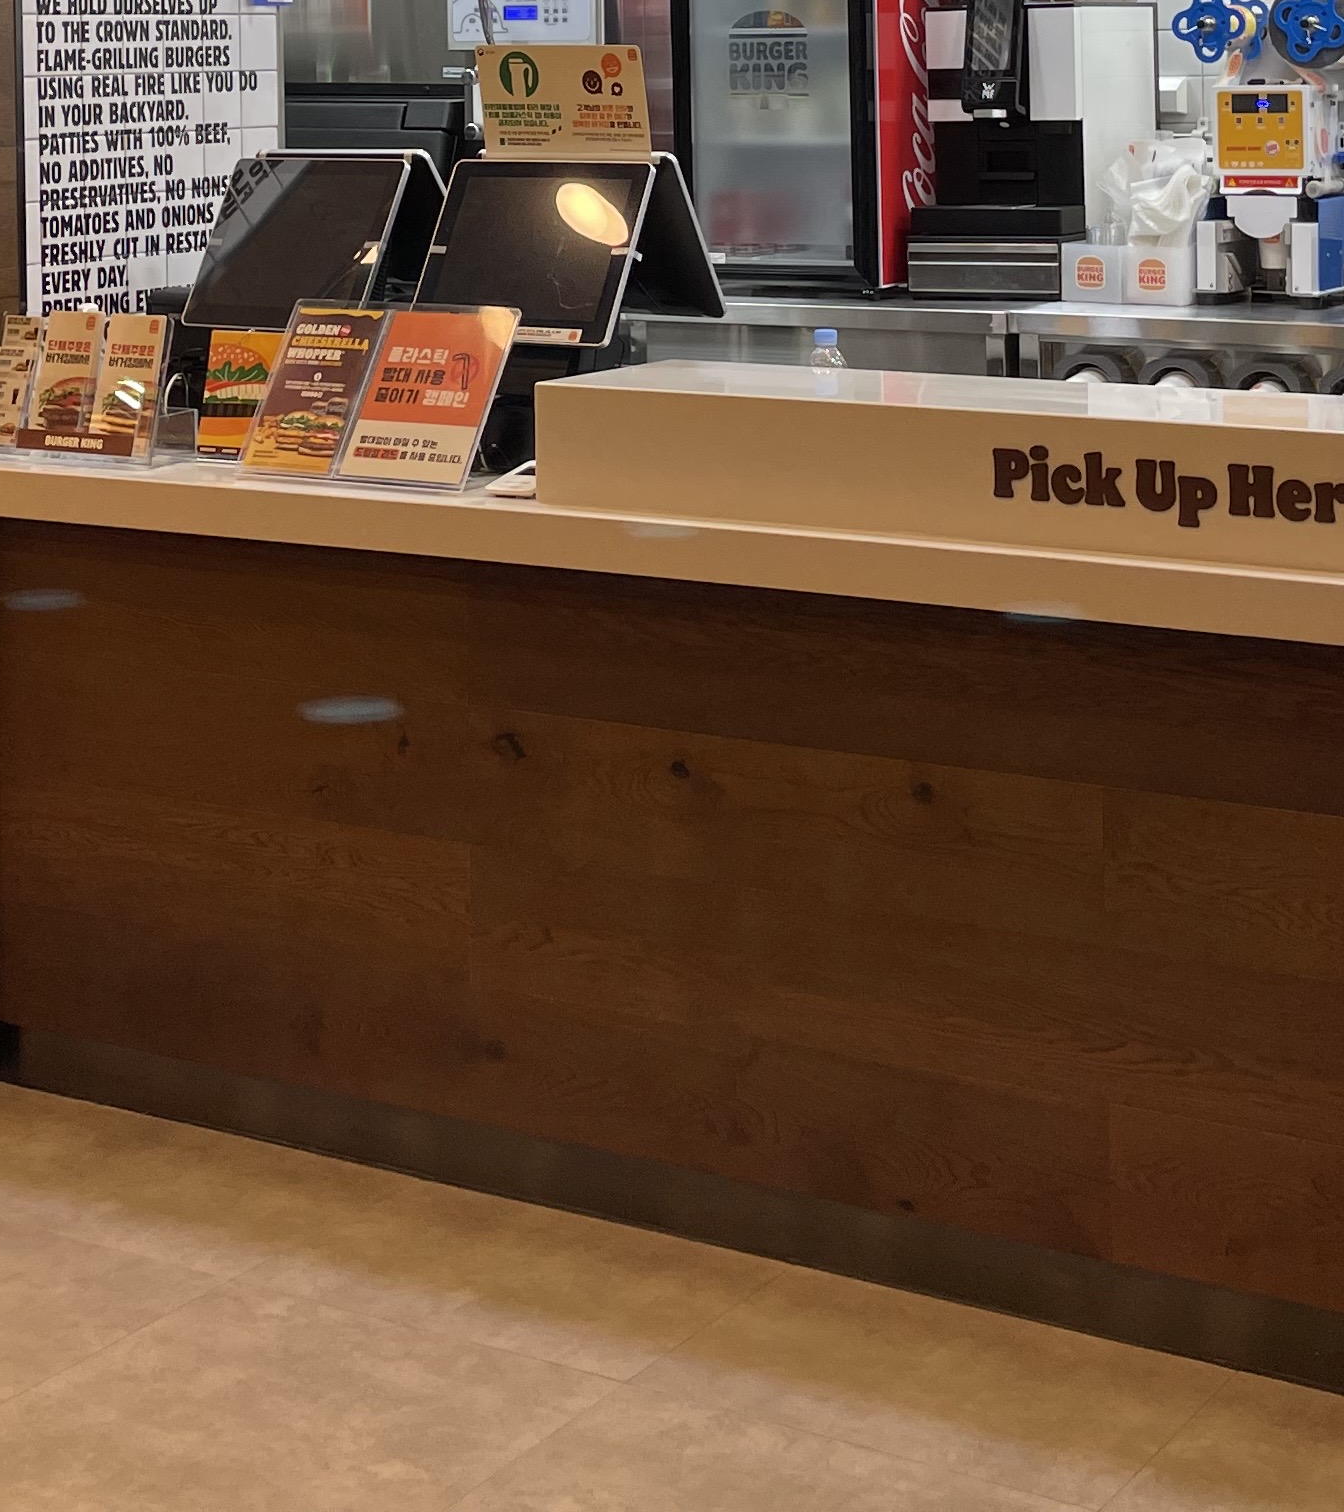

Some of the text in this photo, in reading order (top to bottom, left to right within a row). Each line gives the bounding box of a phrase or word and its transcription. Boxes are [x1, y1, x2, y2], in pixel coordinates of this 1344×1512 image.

[37, 19, 232, 43] TO THE CROWN STANDARD.
[37, 46, 230, 71] FLAME-GRILLING BURGERS
[729, 42, 807, 61] BURGER
[38, 71, 257, 99] USING REAL FIRE LIKE YOU DO
[730, 62, 808, 90] KING
[38, 100, 189, 128] IN YOUR BACKYARD.
[39, 123, 230, 156] PATTIES WITH 100% BEEF,
[39, 154, 173, 184] NO ADDITIVES, NO
[40, 181, 160, 212] PRESERVATIVES,
[165, 178, 186, 201] NO
[40, 202, 214, 238] TOMATOES AND ONIONS
[41, 239, 105, 267] FRESHLY
[113, 238, 139, 259] CUT
[145, 235, 159, 256] IN
[42, 265, 128, 294] EVERY DAY.
[1078, 273, 1103, 281] KING
[1139, 276, 1165, 284] KING
[296, 323, 341, 336] GOLDEN
[286, 347, 342, 360] WHOPPER
[388, 347, 449, 365] 플라스틱
[381, 367, 446, 386] 빨대 사용
[374, 387, 469, 408] 줄이기 캠페인
[45, 435, 103, 449] BURGER KING
[993, 445, 1126, 508] Pick
[1135, 459, 1217, 527] Up
